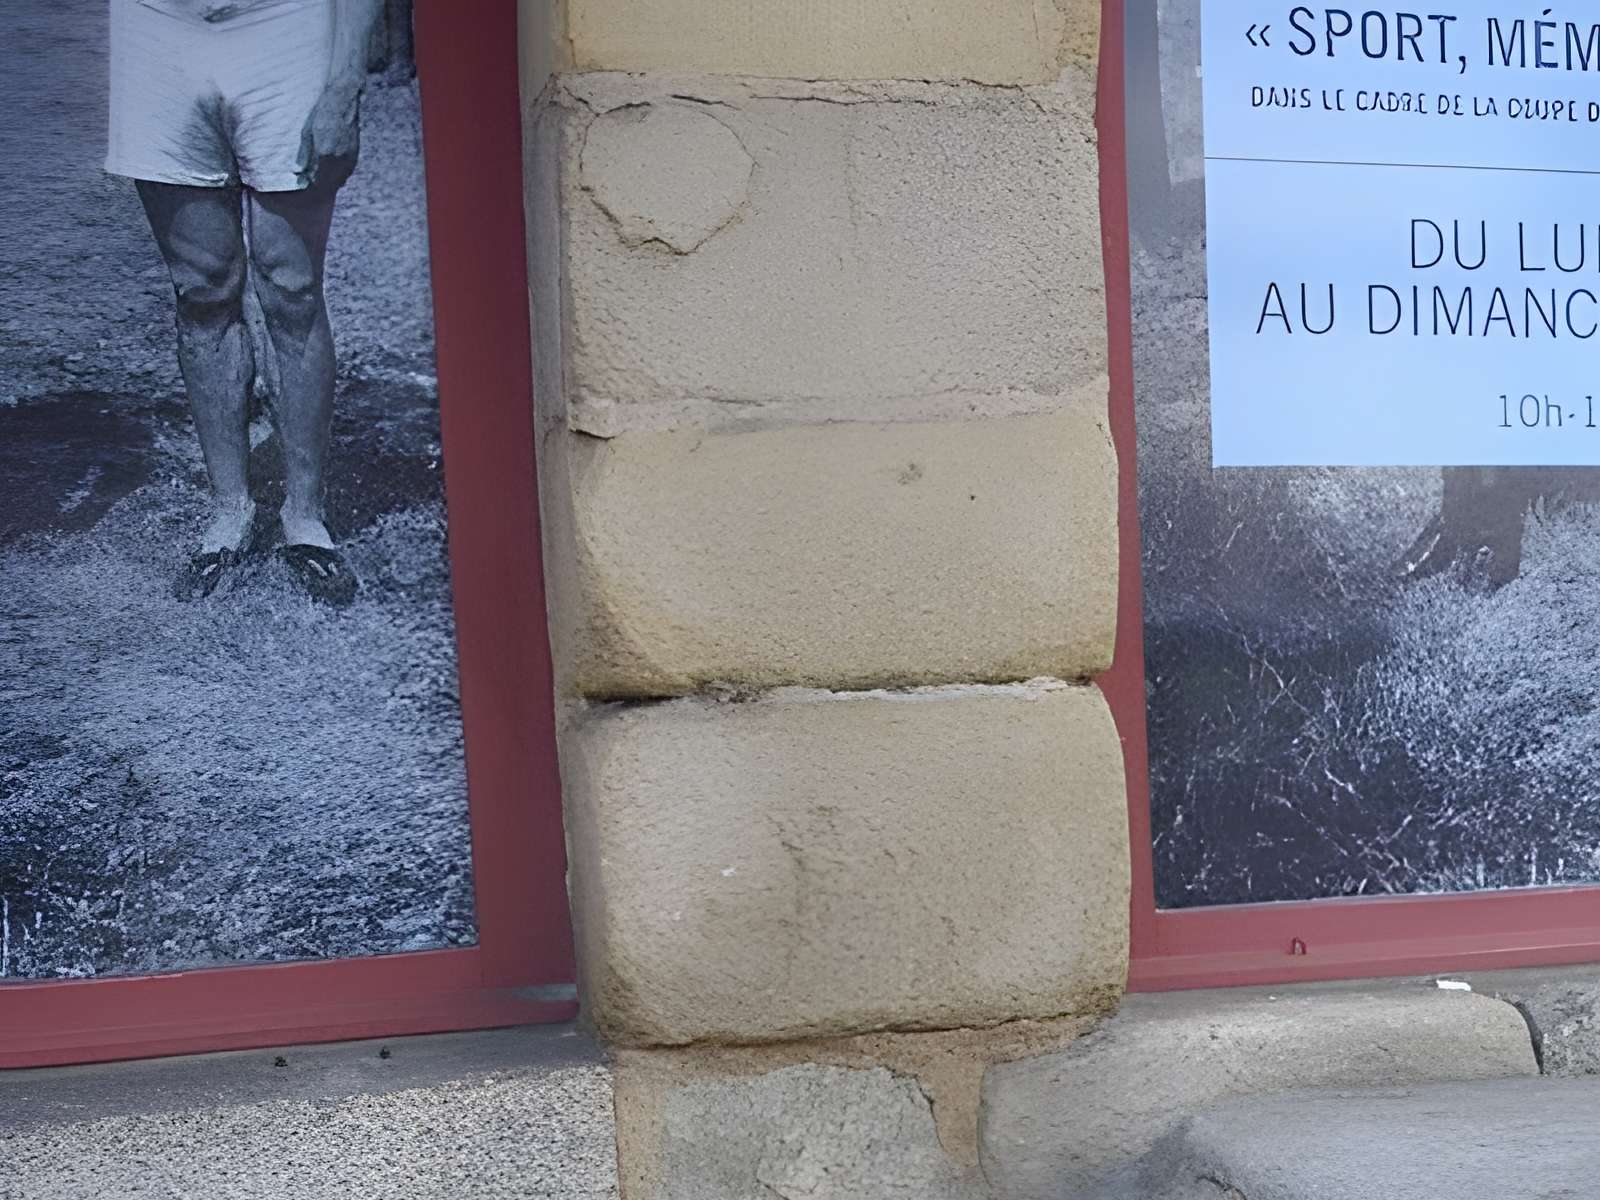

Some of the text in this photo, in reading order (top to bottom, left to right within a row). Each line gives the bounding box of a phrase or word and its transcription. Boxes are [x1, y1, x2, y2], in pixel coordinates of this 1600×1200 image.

[1288, 6, 1467, 75] SPORT,
[1437, 94, 1465, 116] DE
[1473, 96, 1499, 117] LA
[1410, 218, 1487, 271] DU
[1255, 281, 1335, 335] AU
